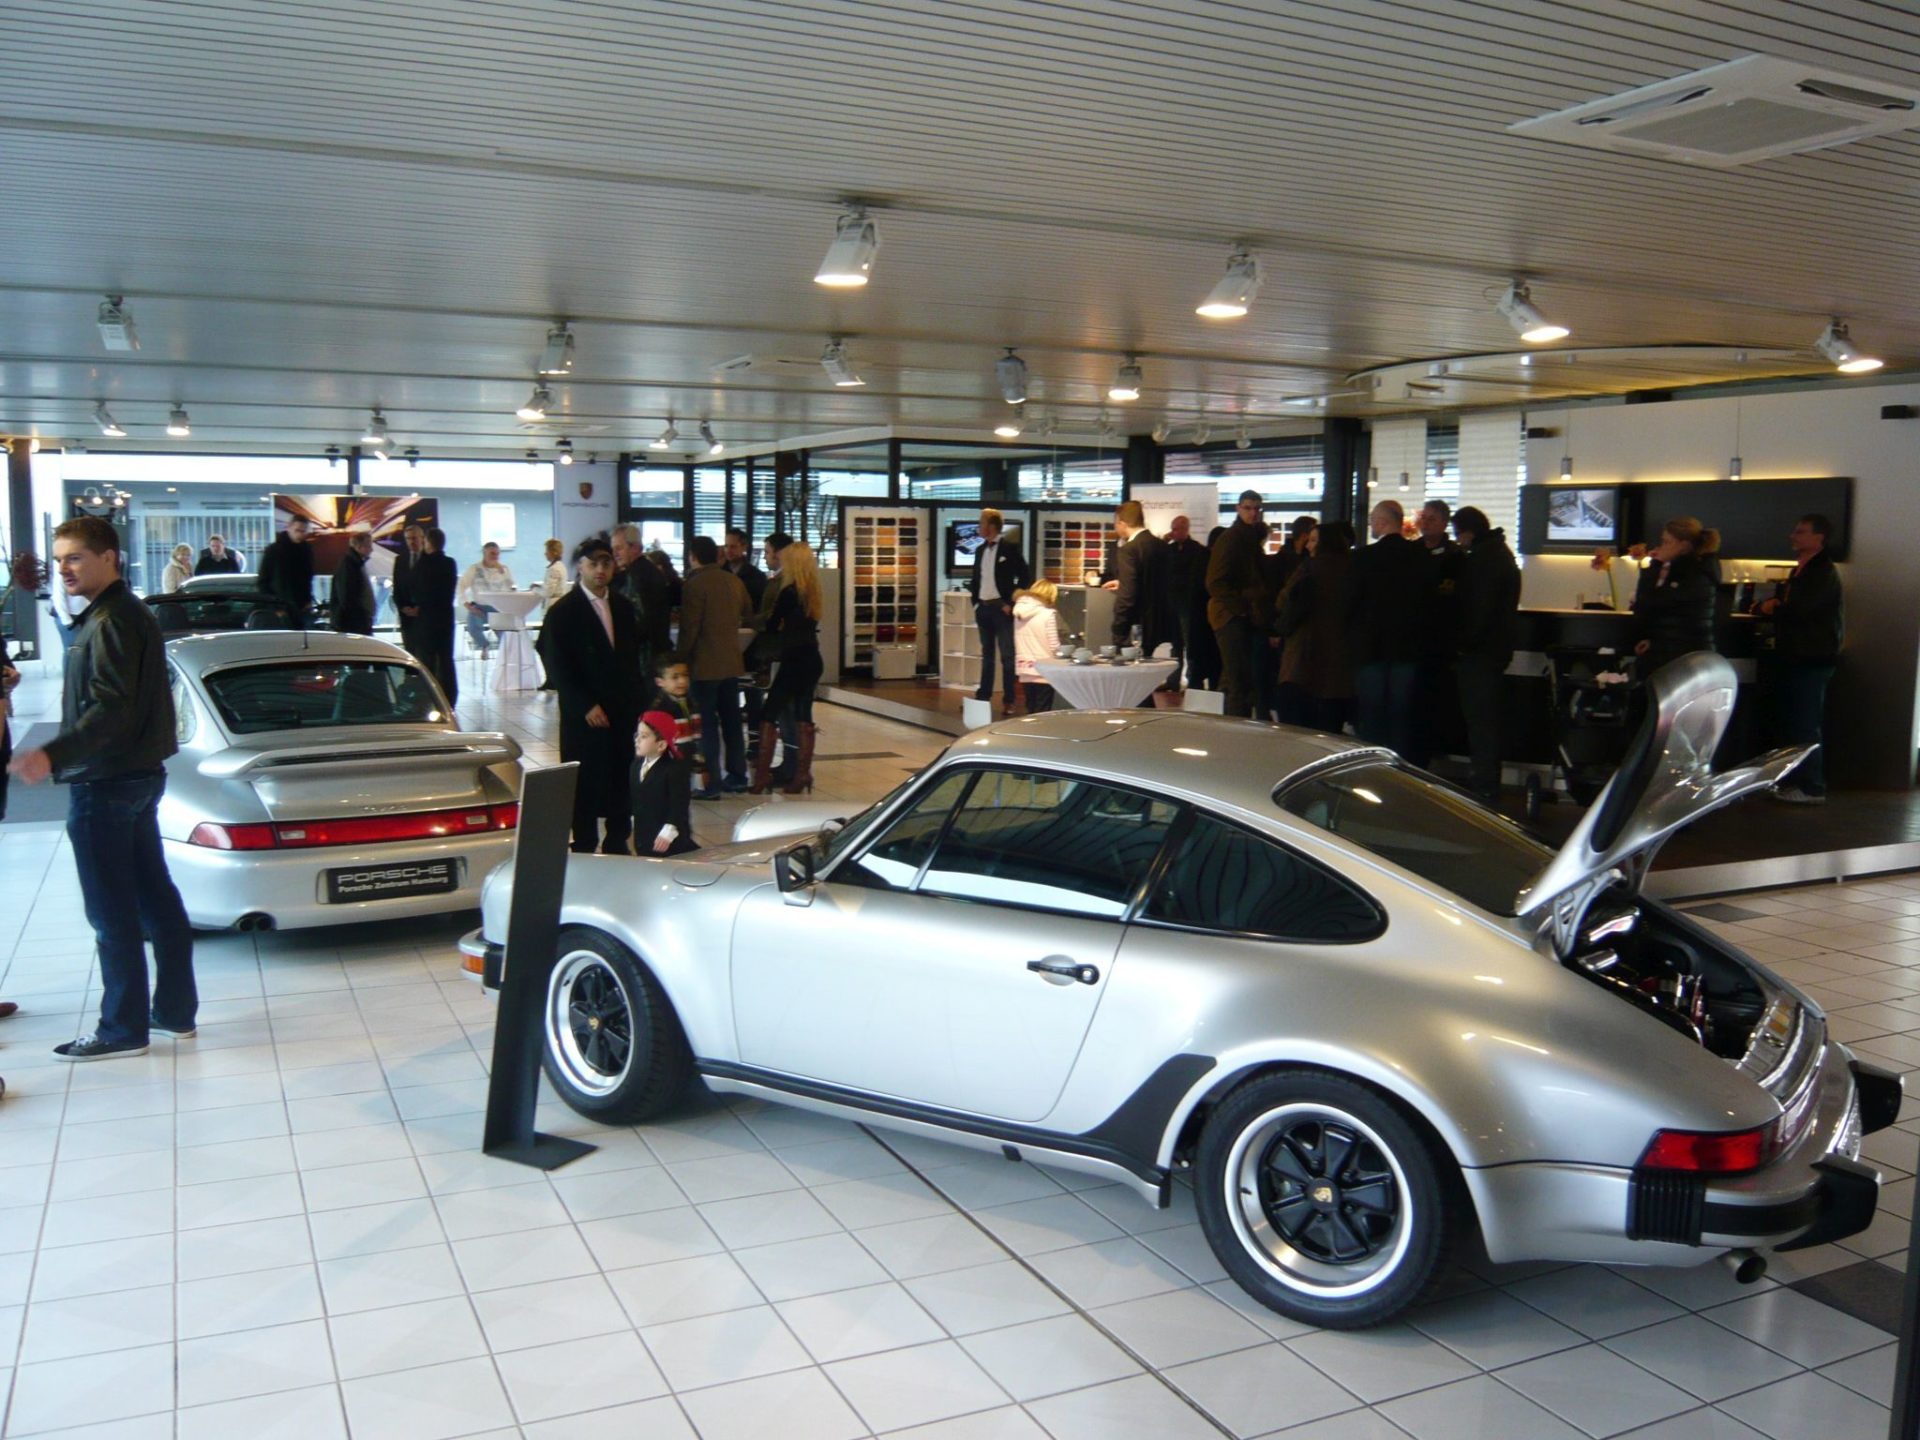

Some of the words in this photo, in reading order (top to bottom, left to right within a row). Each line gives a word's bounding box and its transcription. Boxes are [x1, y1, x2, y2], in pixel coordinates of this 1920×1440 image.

[337, 864, 448, 884] PORSCHE
[338, 884, 374, 893] Porsche
[374, 880, 410, 889] Zentrum
[411, 876, 448, 885] Hamburg
